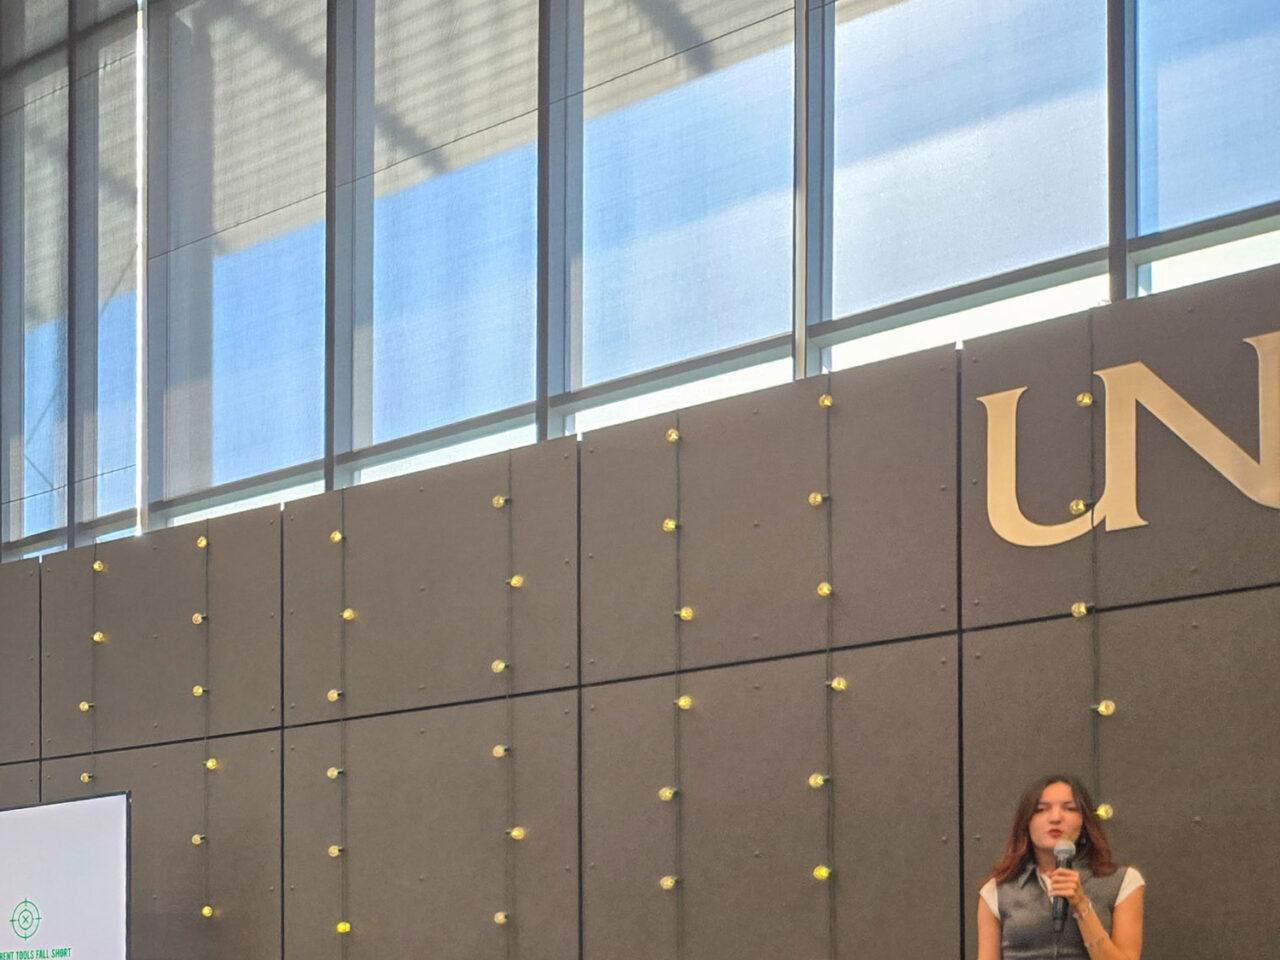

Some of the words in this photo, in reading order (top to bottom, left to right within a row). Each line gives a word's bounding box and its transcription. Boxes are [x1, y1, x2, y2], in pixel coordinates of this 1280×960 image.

[15, 950, 34, 960] TOOLS
[35, 949, 49, 959] FALL
[51, 947, 72, 958] SHORT
